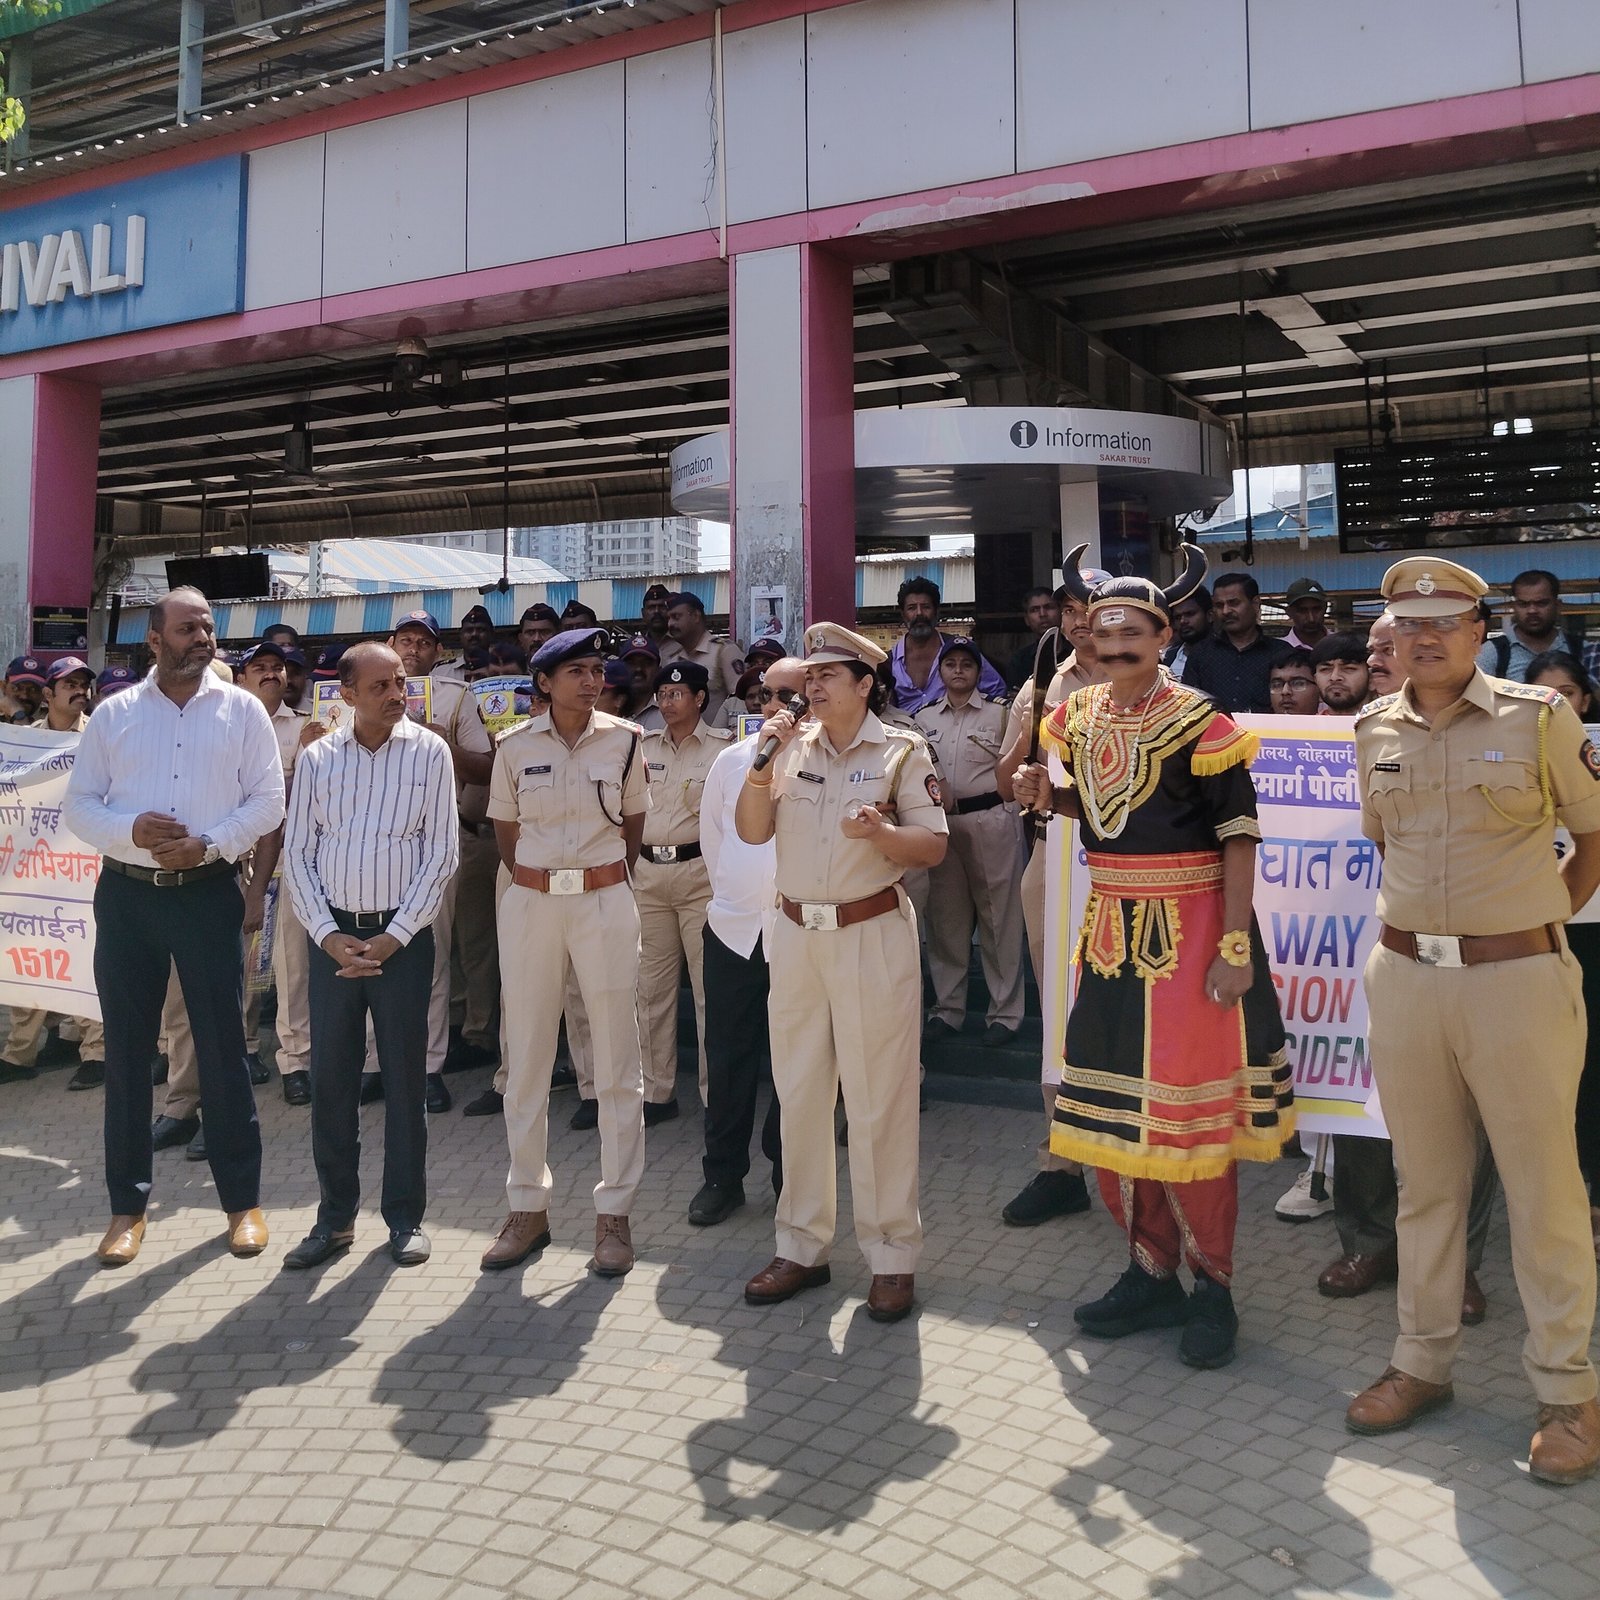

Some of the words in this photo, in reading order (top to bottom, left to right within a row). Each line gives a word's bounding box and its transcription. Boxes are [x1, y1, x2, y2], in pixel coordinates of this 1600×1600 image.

[0, 215, 145, 312] IVALI
[1046, 427, 1152, 452] Information
[1099, 454, 1126, 463] SAKAR
[1128, 456, 1151, 464] TRUST
[1307, 765, 1360, 803] पोली
[30, 801, 63, 837] मुंबई
[13, 838, 101, 884] अभियान
[0, 906, 87, 943] पलाईन
[1271, 912, 1367, 968] WAY
[5, 947, 72, 982] 1512
[1284, 1031, 1373, 1089] CIDEN
